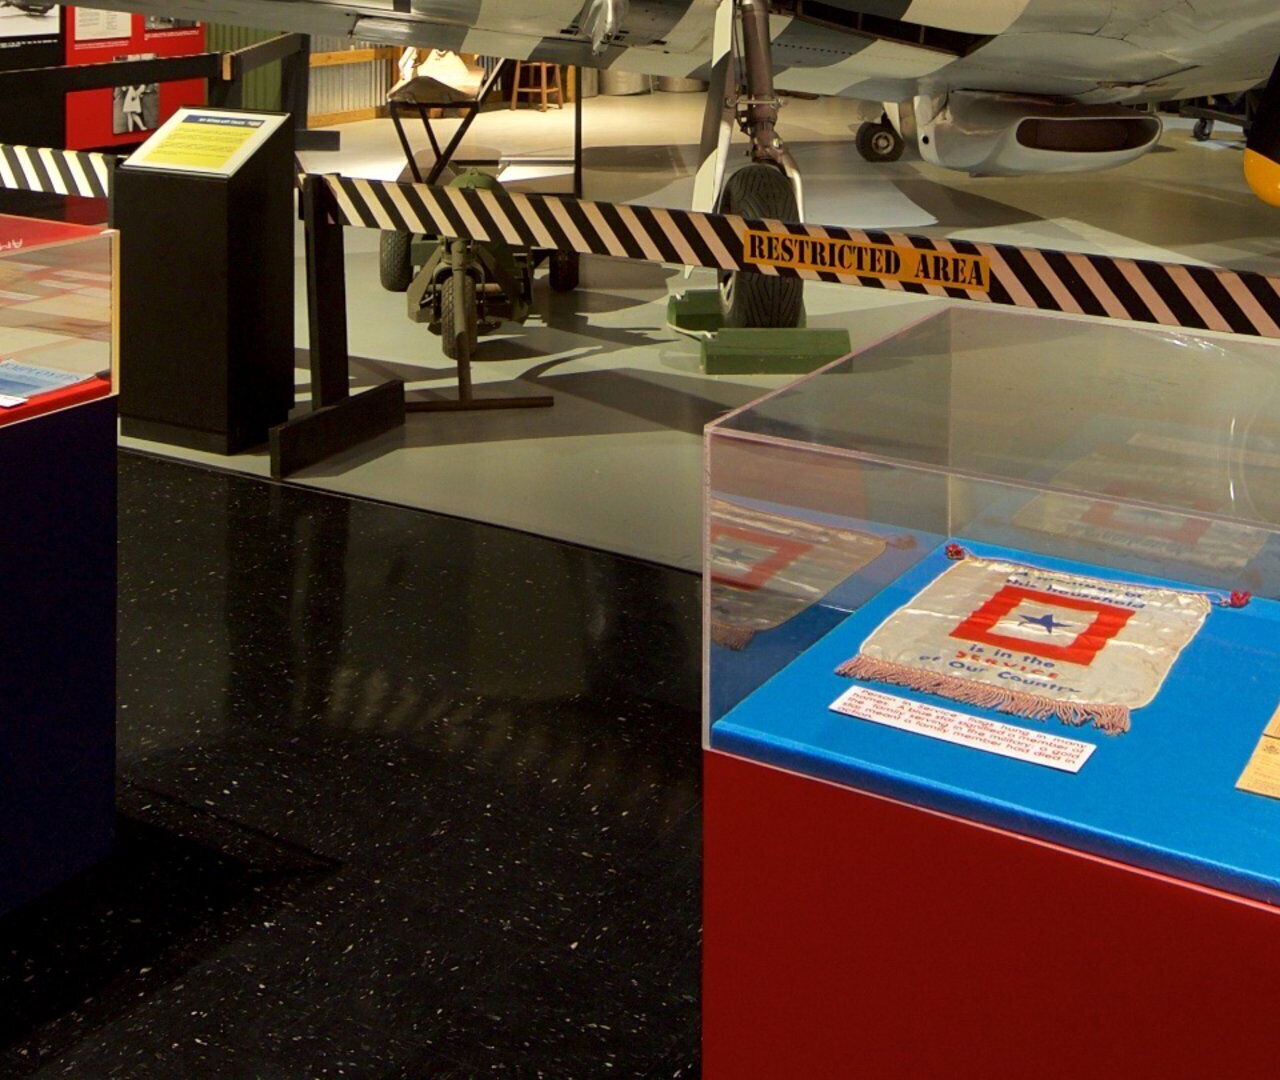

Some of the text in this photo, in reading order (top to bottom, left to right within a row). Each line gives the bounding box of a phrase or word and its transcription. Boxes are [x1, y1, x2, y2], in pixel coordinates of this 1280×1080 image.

[749, 234, 984, 286] RESTRICTED AREA
[955, 650, 1059, 679] SERVICE
[970, 644, 1056, 668] is in the
[949, 660, 988, 673] Our
[998, 671, 1082, 693] Country
[953, 730, 1002, 747] member
[1033, 749, 1061, 762] died
[1018, 732, 1062, 750] member
[1052, 748, 1080, 761] gold
